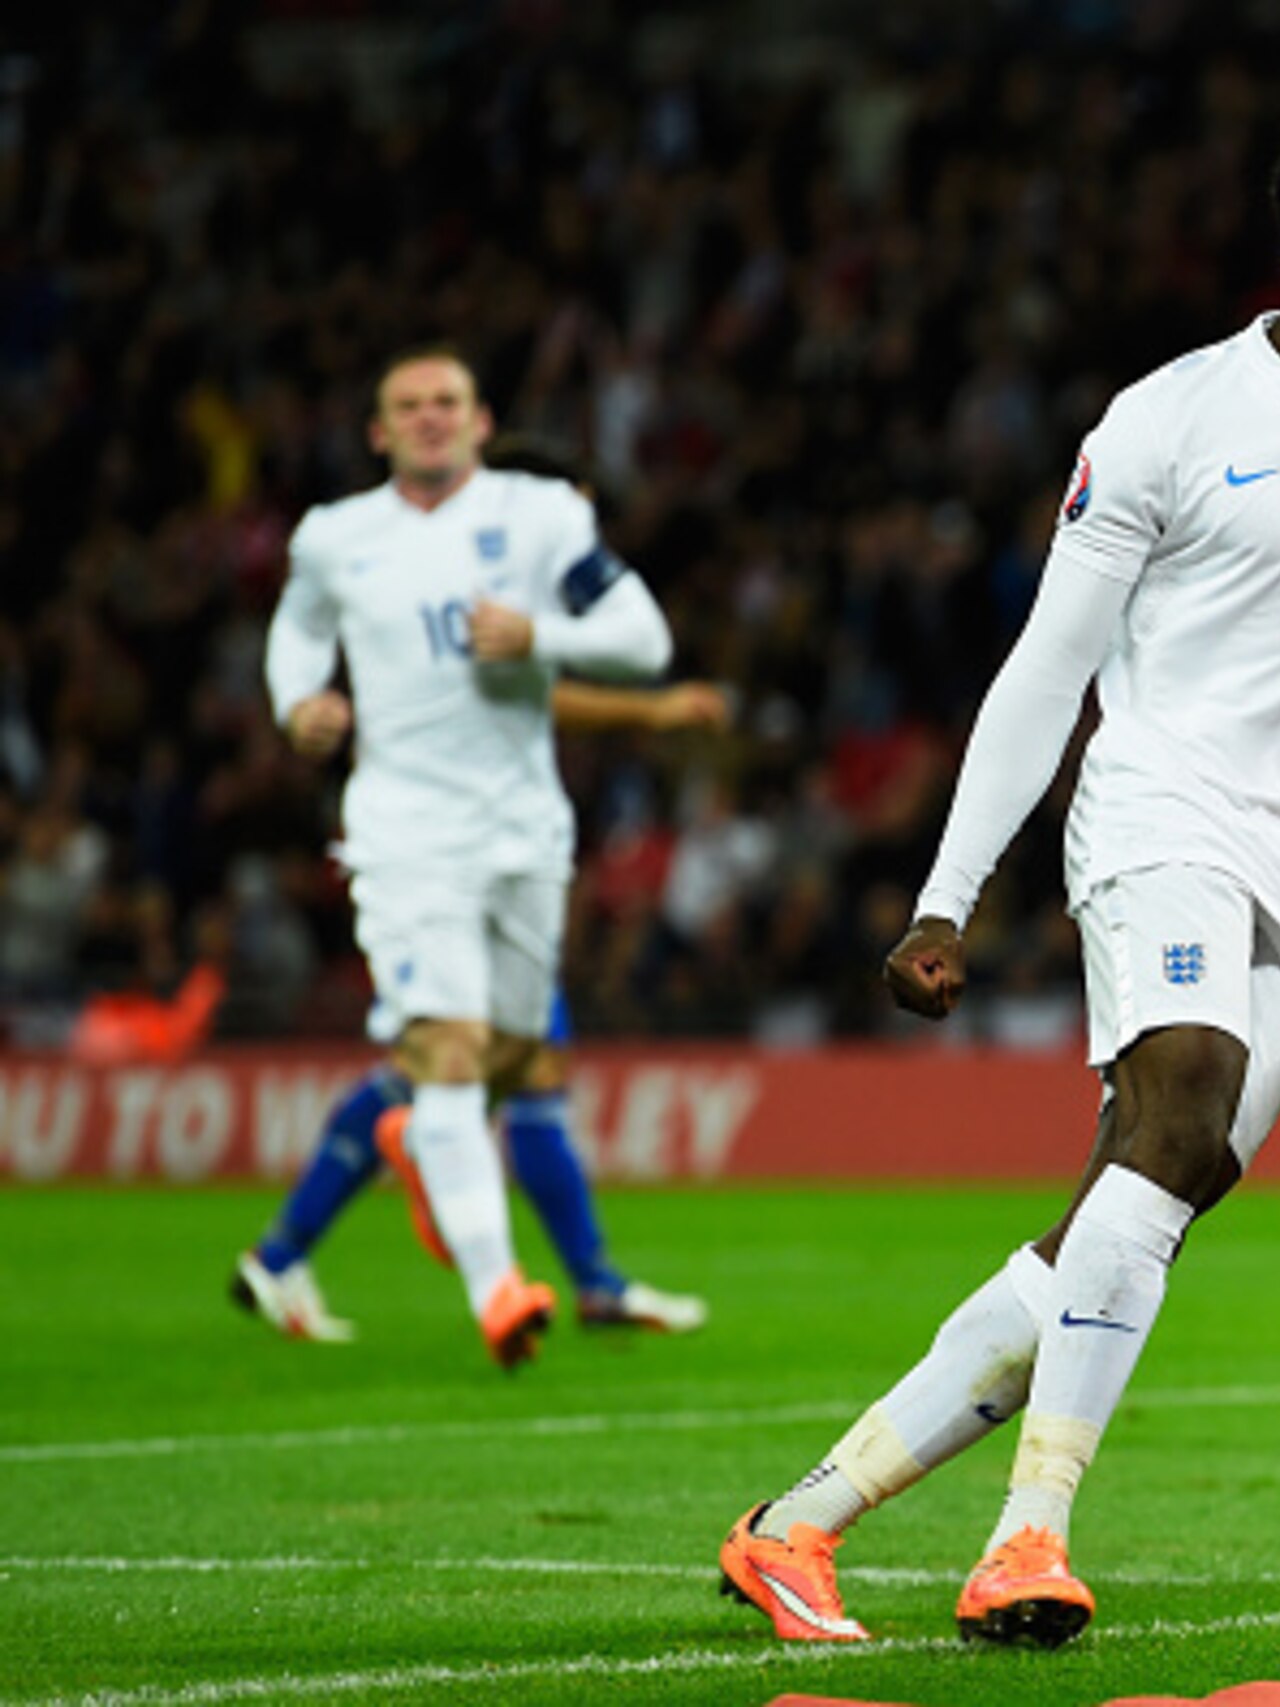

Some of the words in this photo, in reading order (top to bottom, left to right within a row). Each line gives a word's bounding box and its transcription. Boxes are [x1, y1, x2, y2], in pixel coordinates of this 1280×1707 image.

[418, 599, 477, 661] 10
[0, 1065, 87, 1181] U
[106, 1065, 232, 1181] TO
[252, 1065, 761, 1179] WLEY
